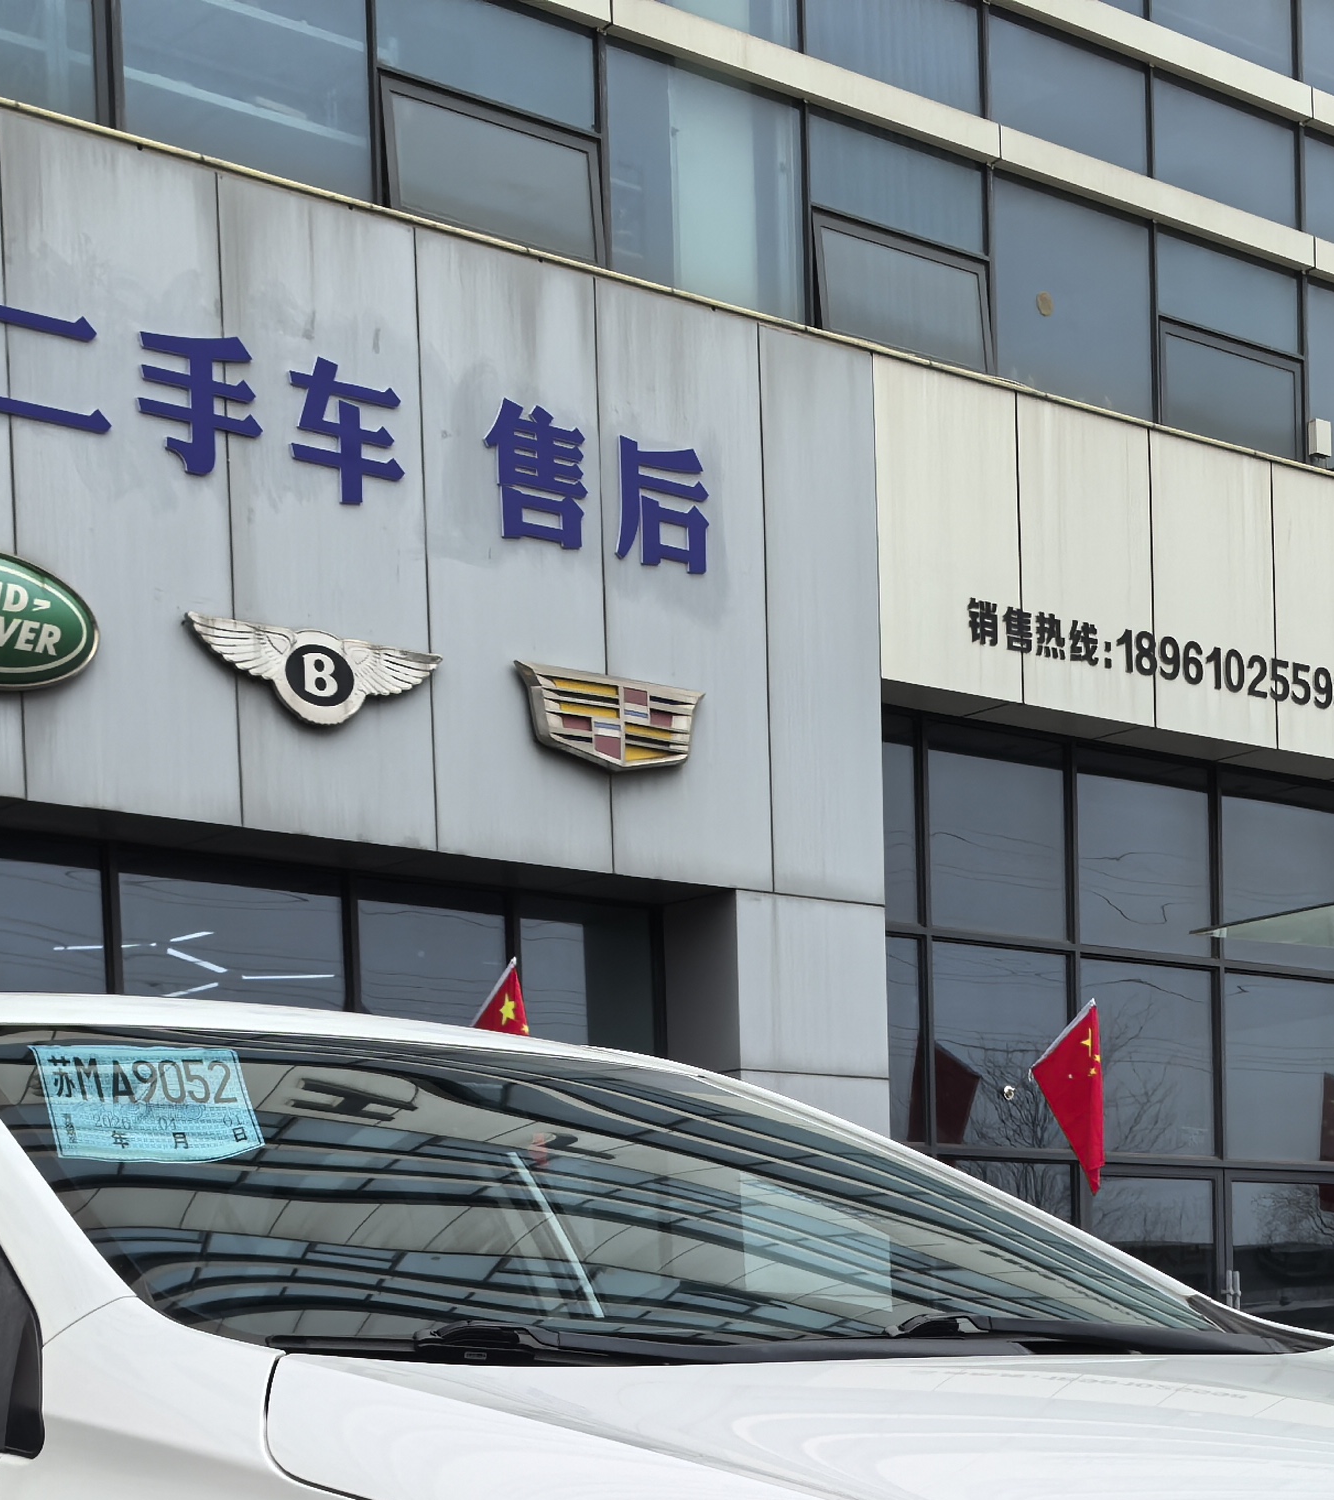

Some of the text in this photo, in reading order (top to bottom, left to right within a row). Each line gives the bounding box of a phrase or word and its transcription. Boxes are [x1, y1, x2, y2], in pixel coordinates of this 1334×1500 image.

[484, 397, 710, 574] 售后
[48, 1054, 238, 1104] 苏MA9052
[111, 1126, 247, 1149] 年 月 日
